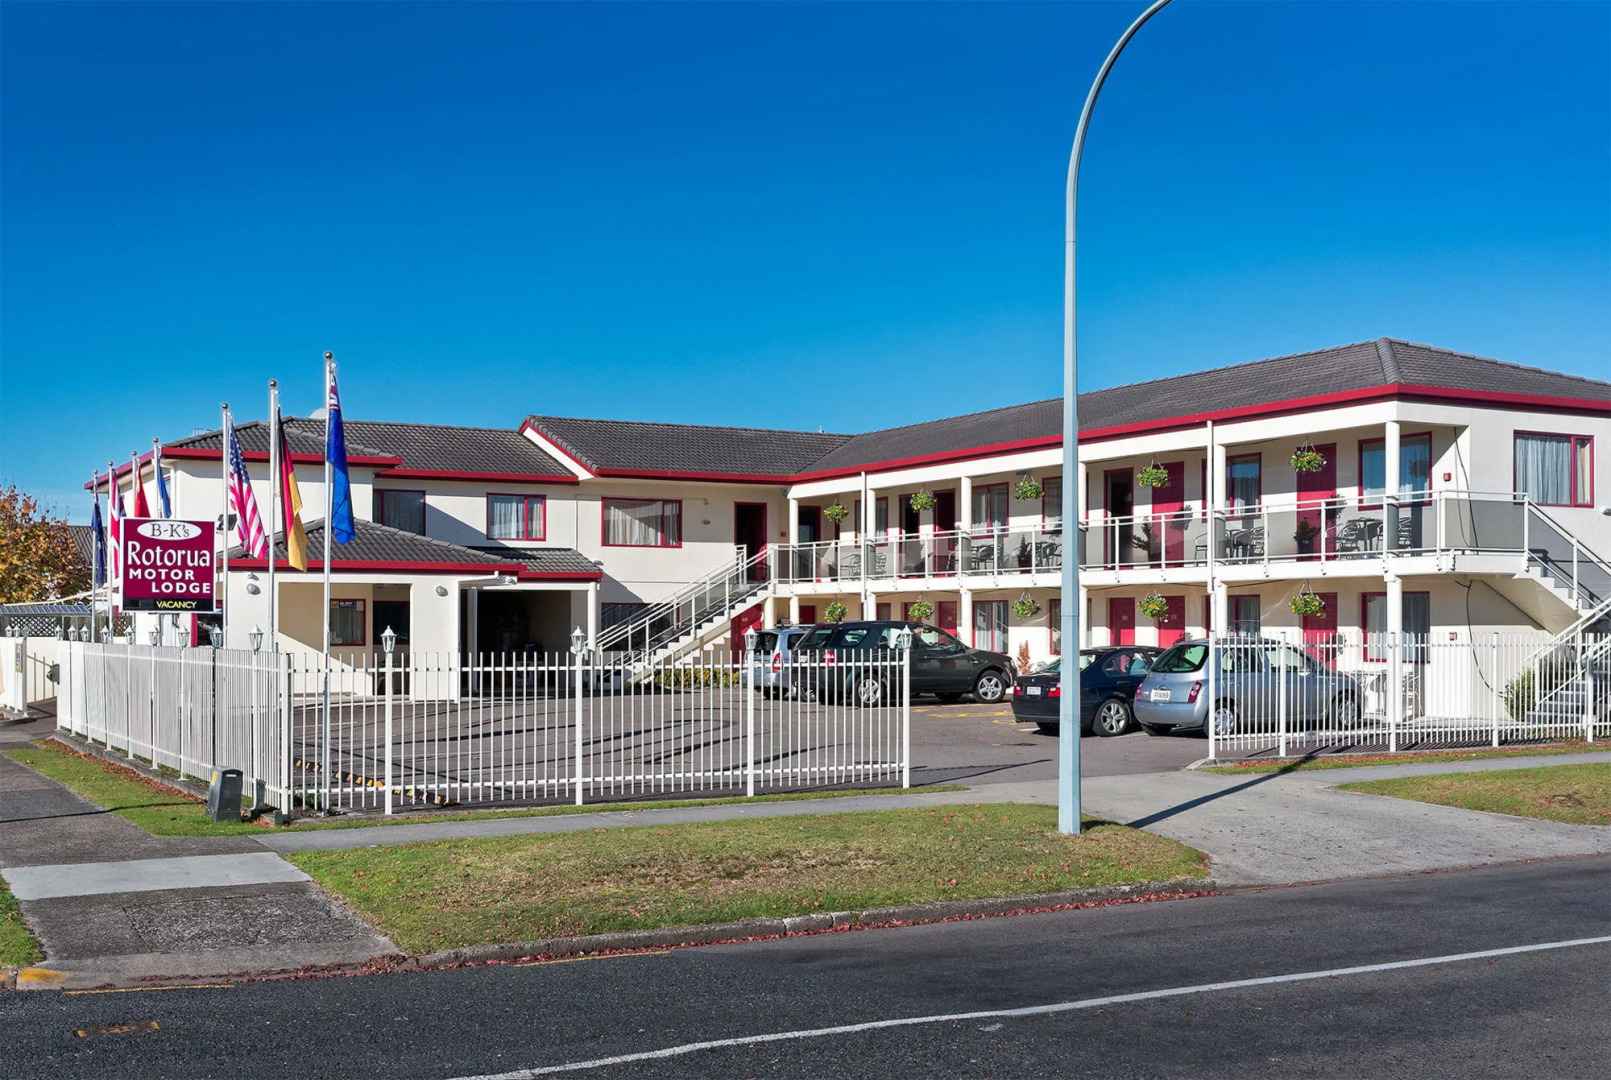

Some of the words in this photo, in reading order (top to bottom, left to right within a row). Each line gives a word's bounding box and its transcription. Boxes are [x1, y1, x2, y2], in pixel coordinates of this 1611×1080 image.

[127, 540, 210, 567] Rotorua
[129, 568, 195, 580] MOTOR
[151, 582, 211, 594] LODGE
[156, 601, 198, 609] VACANCY
